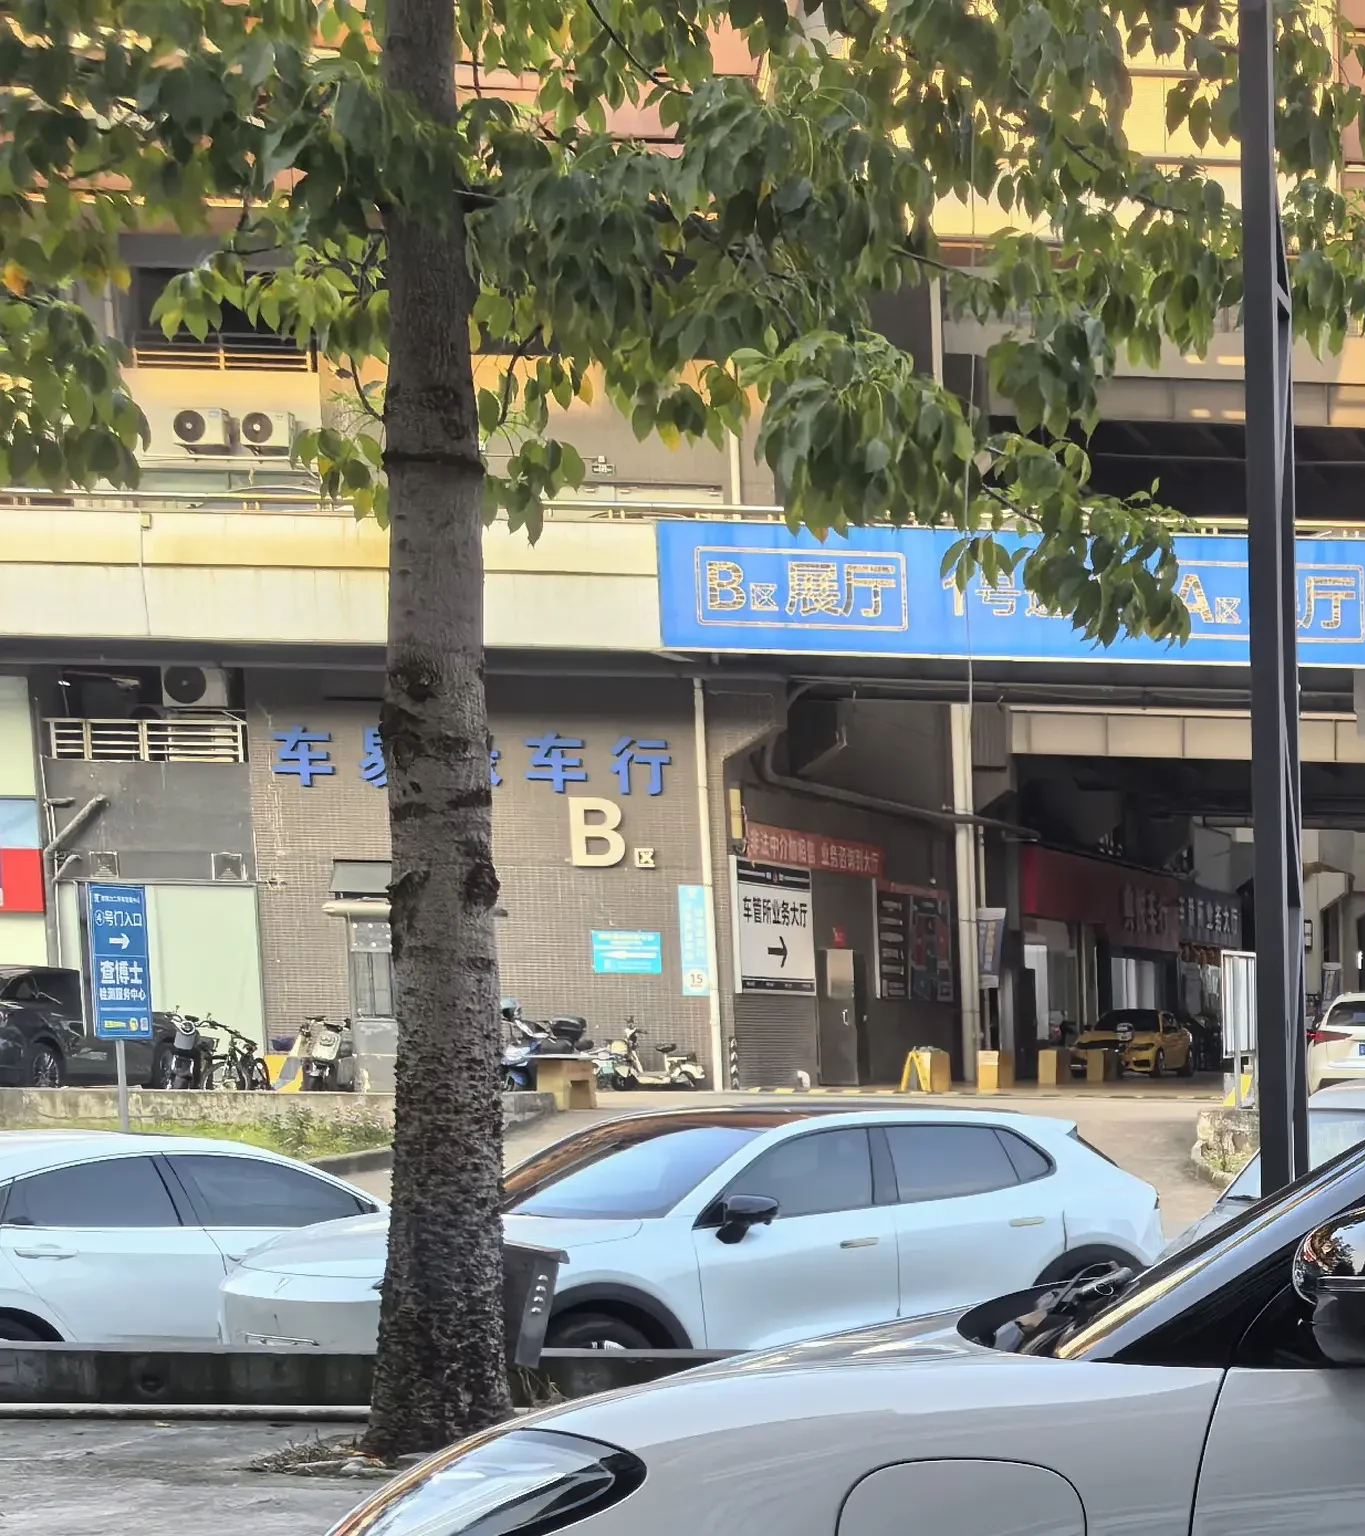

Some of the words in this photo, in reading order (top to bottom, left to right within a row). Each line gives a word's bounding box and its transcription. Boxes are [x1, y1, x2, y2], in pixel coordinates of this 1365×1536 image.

[706, 560, 897, 618] B区展厅
[1178, 574, 1356, 629] A区厅
[272, 727, 672, 796] 车车行
[568, 797, 656, 867] B区
[743, 895, 808, 928] 车管所业务大厅
[100, 960, 143, 985] 查博士
[690, 973, 703, 984] 15
